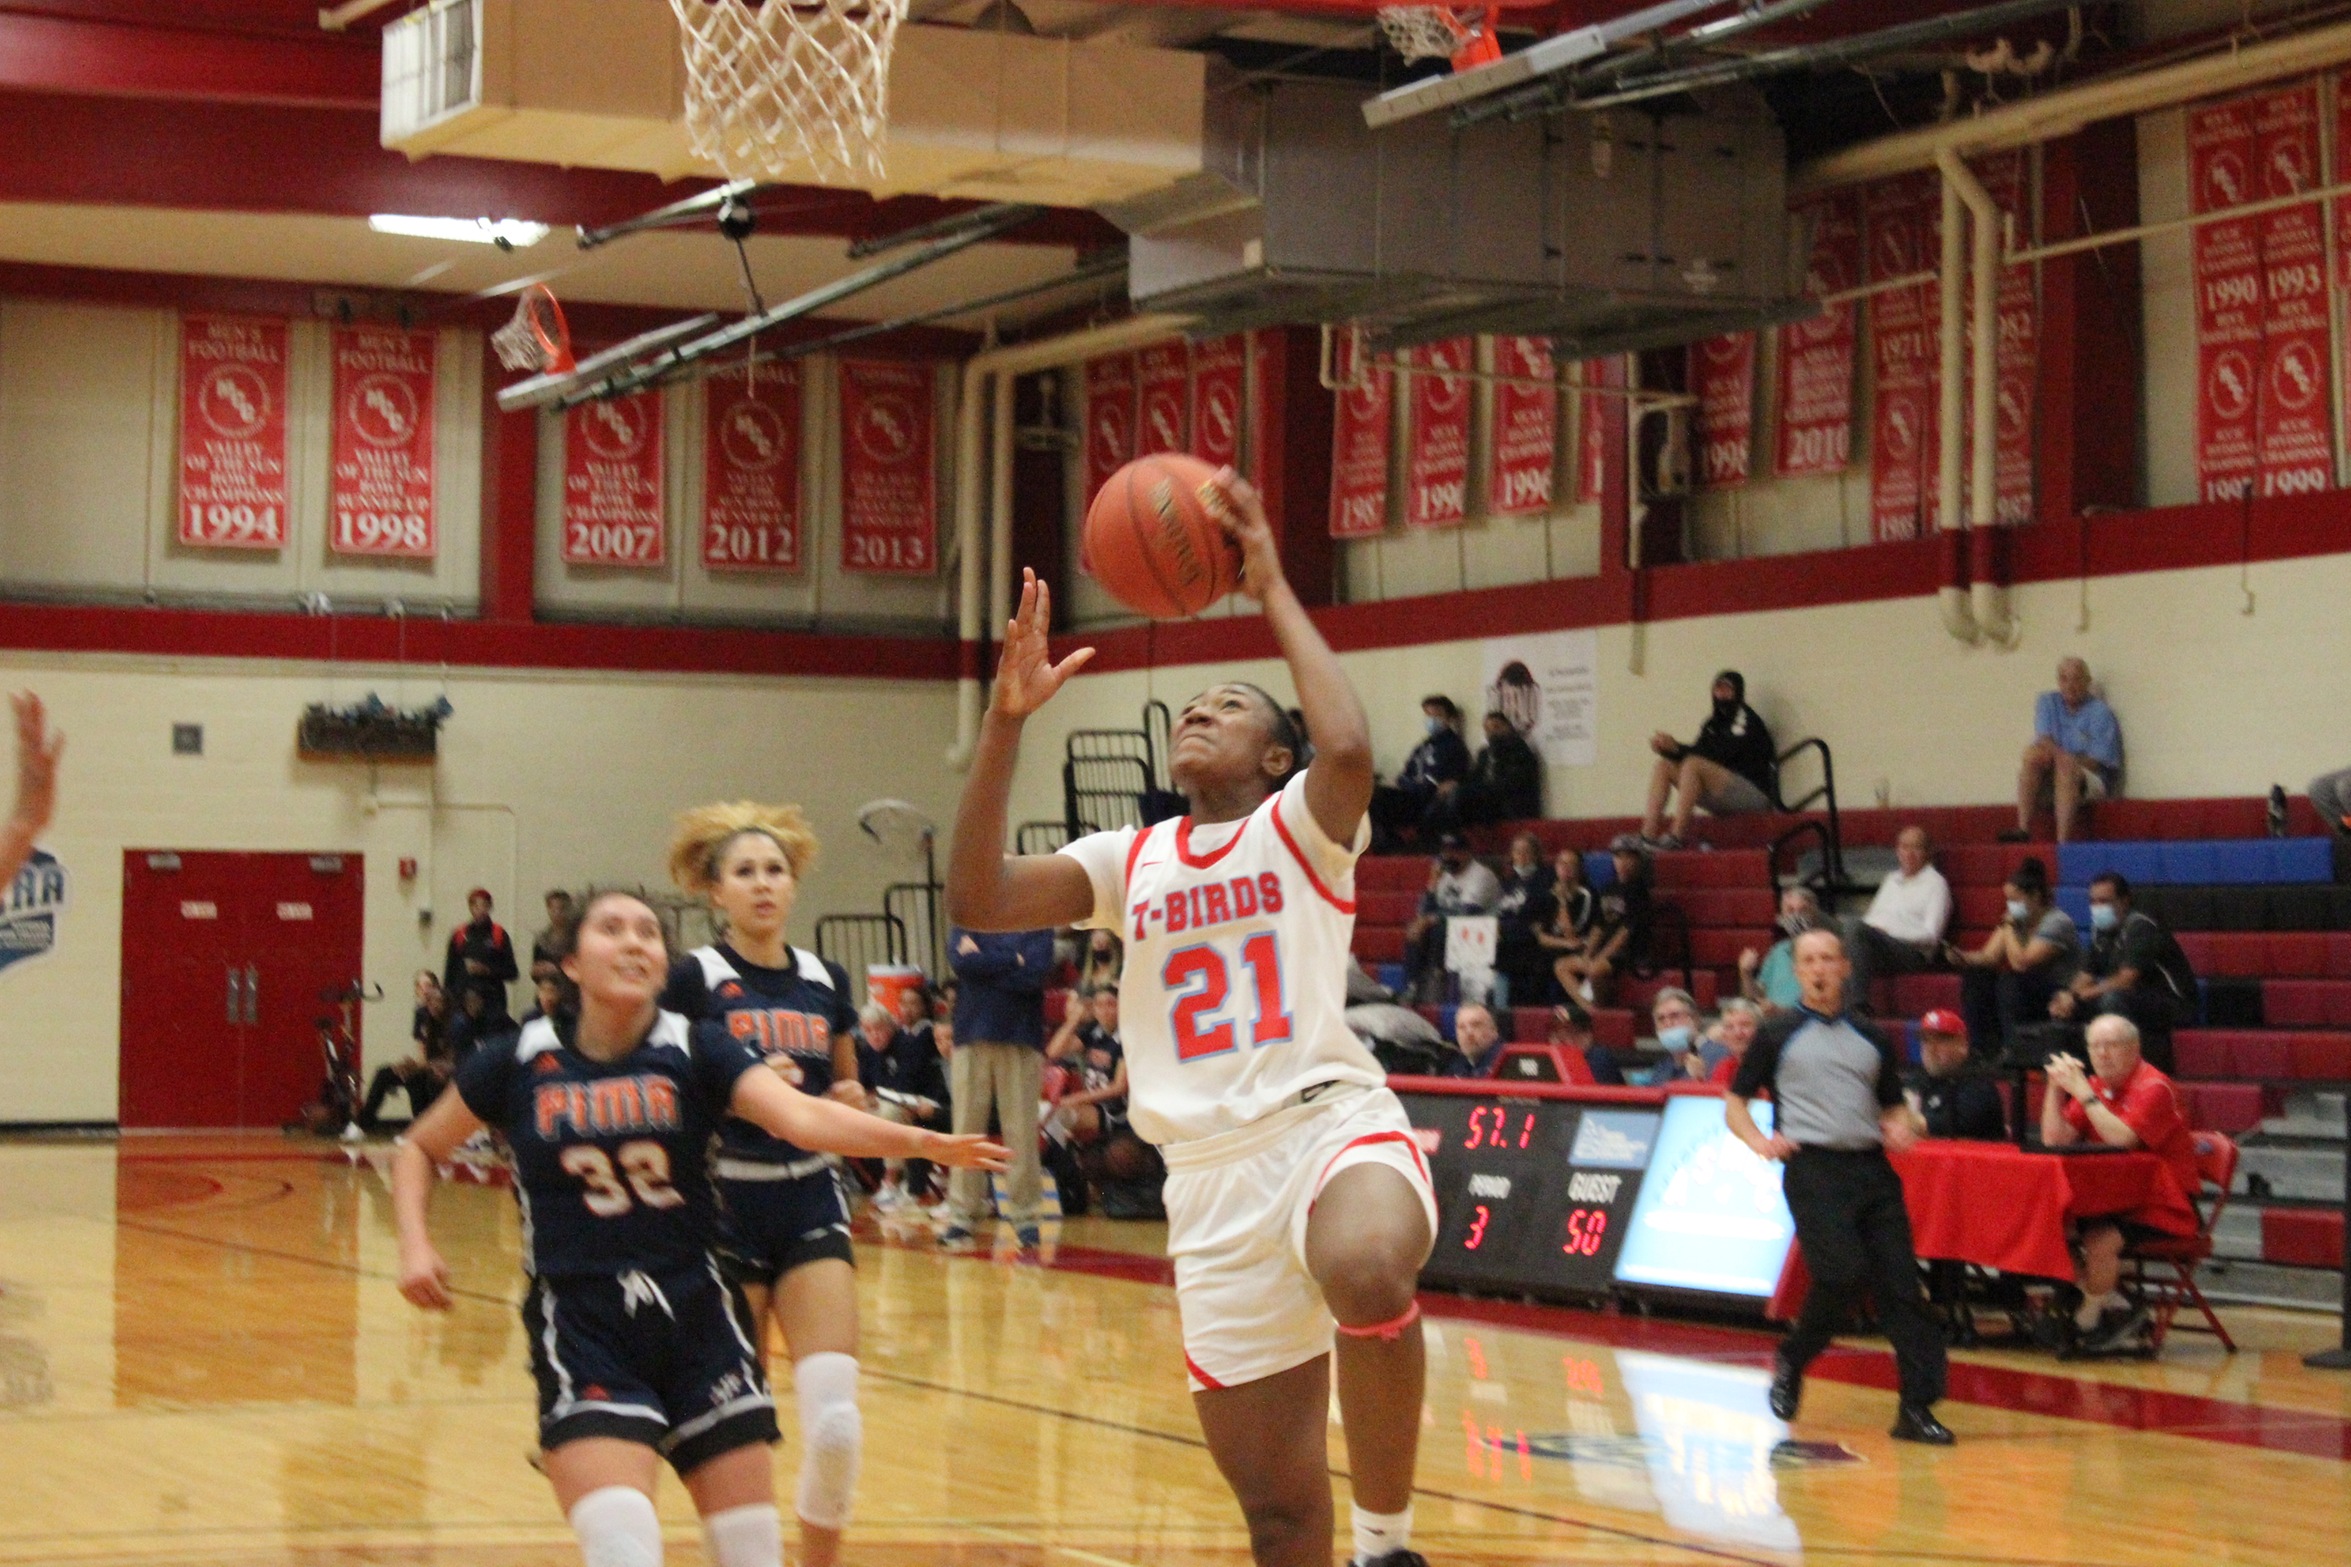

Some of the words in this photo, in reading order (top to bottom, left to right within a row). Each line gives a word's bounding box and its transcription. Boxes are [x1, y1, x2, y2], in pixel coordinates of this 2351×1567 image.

[2206, 274, 2259, 311] 1990
[2267, 263, 2321, 299] 1993
[190, 503, 278, 539] 1994
[338, 512, 427, 549] 1998
[569, 522, 656, 559] 2007
[708, 523, 794, 560] 2012
[850, 534, 924, 569] 2013
[1131, 871, 1284, 941] T-BIRDS
[1161, 930, 1294, 1064] 21
[725, 1007, 831, 1060] PIMA
[535, 1074, 685, 1142] PIMA
[559, 1139, 686, 1218] 32
[1567, 1171, 1622, 1204] GUEST
[1464, 1206, 1490, 1250] 3
[1562, 1209, 1607, 1256] 50
